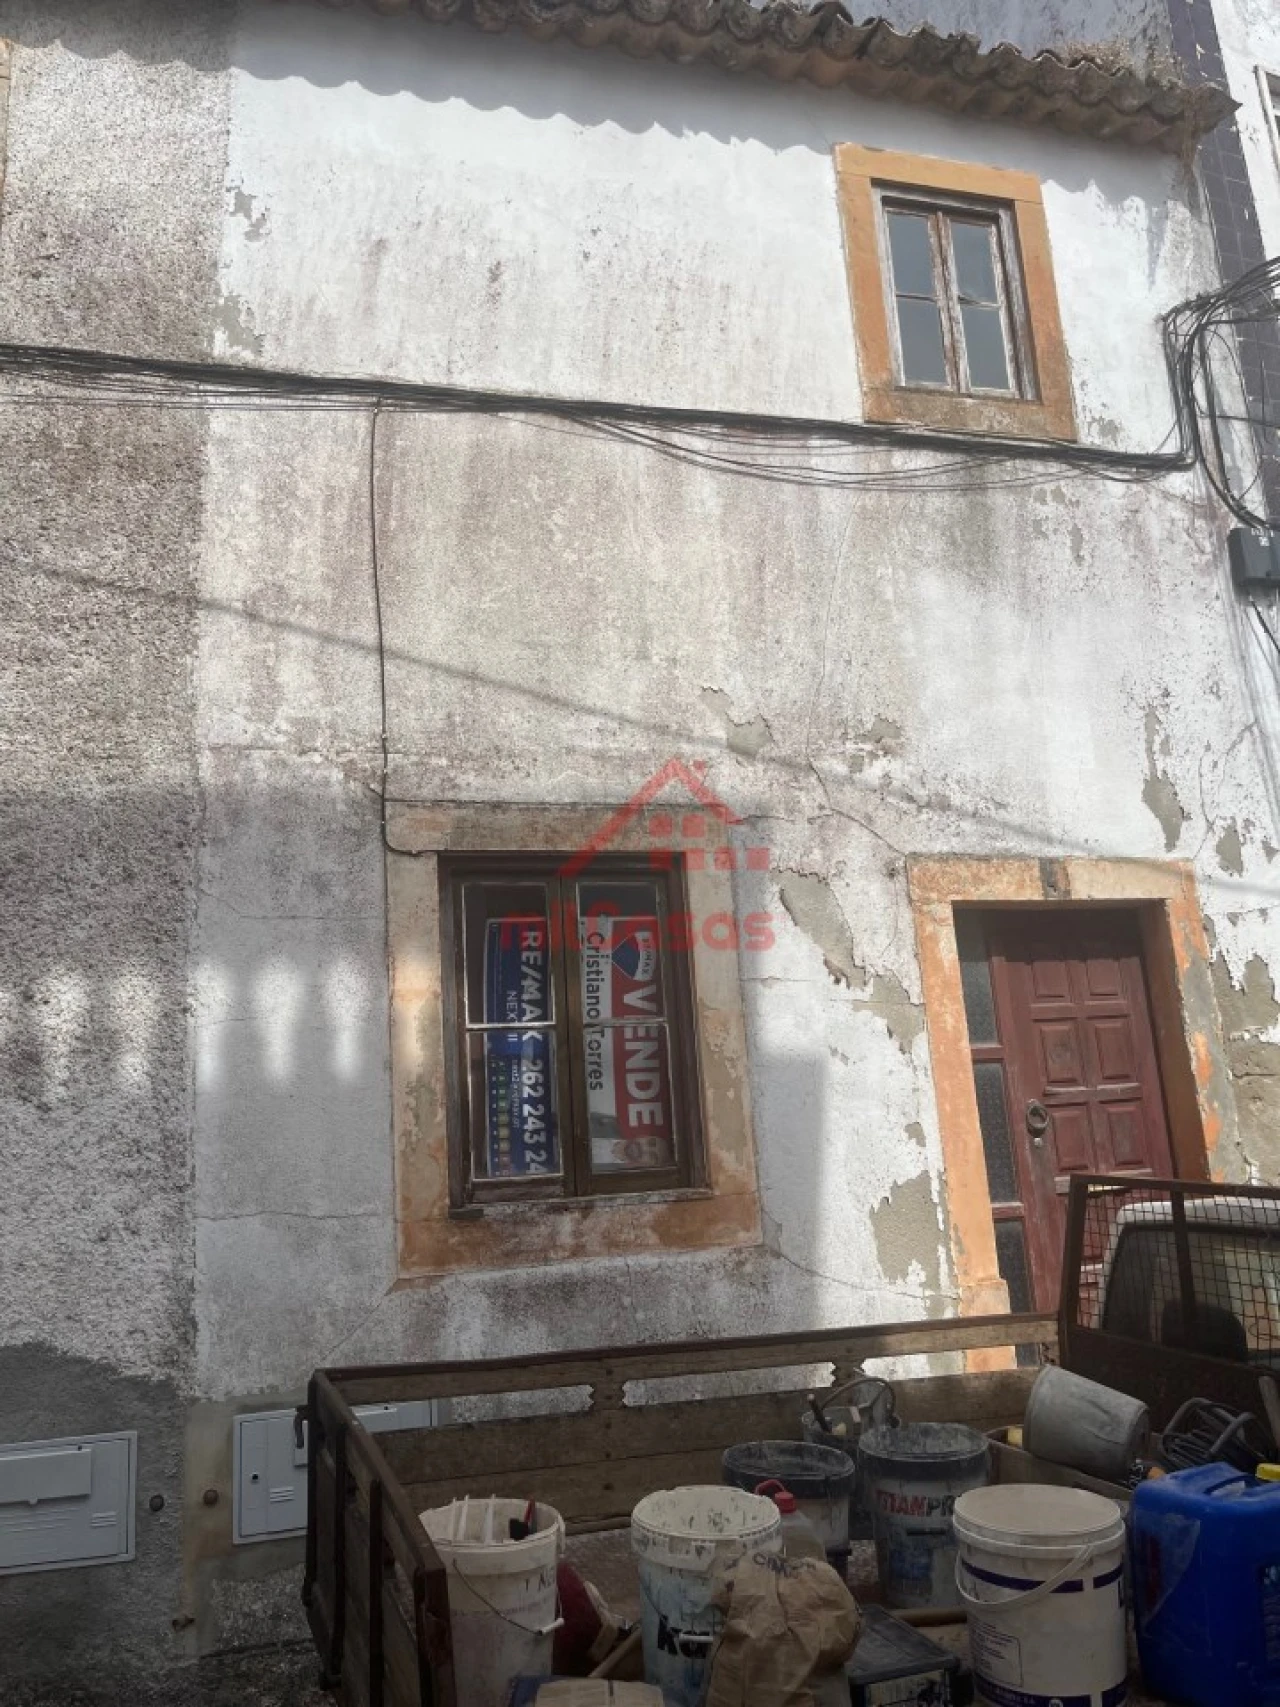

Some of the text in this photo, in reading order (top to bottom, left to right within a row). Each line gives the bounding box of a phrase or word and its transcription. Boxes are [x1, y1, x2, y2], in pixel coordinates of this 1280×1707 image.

[506, 990, 519, 1028] NEX
[521, 931, 543, 1042] RE/MAX
[586, 931, 606, 1091] Cristiano Torres
[522, 1059, 545, 1098] 262
[623, 984, 664, 1127] VENDE
[522, 1103, 547, 1144] 243
